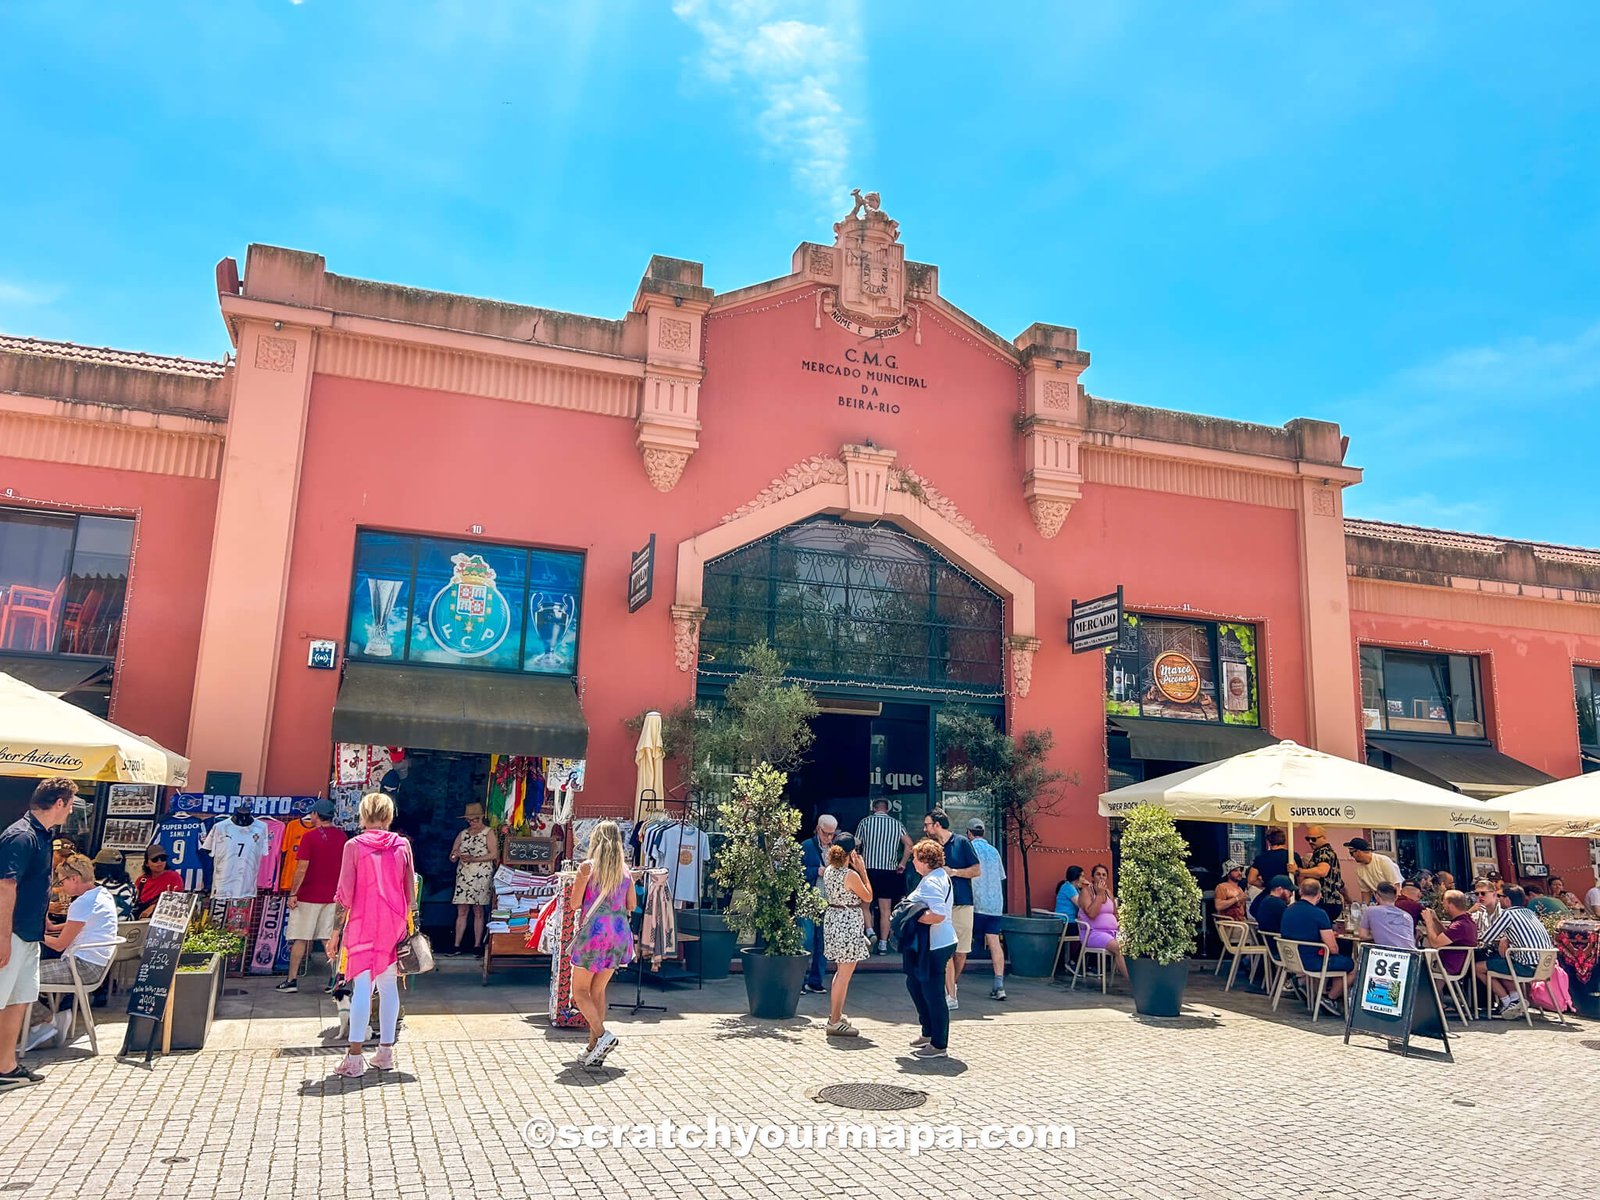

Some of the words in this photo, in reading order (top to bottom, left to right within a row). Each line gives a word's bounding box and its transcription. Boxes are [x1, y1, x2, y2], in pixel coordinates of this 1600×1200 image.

[831, 310, 853, 330] NOME
[857, 326, 863, 334] E
[801, 360, 861, 378] MERCADO
[866, 370, 927, 388] MUNICIPAL
[838, 396, 900, 414] BEIRA-RIO
[5, 488, 13, 497] 9
[472, 525, 482, 534] 10
[1075, 613, 1116, 633] MERCADO
[1160, 664, 1191, 675] Marco
[885, 772, 923, 790] que
[201, 794, 226, 813] FC
[1290, 807, 1317, 817] SUPER
[1317, 807, 1341, 817] BOCK
[161, 823, 182, 831] SUPER
[172, 839, 186, 865] 9
[237, 843, 245, 857] 7
[1374, 958, 1401, 979] 8€
